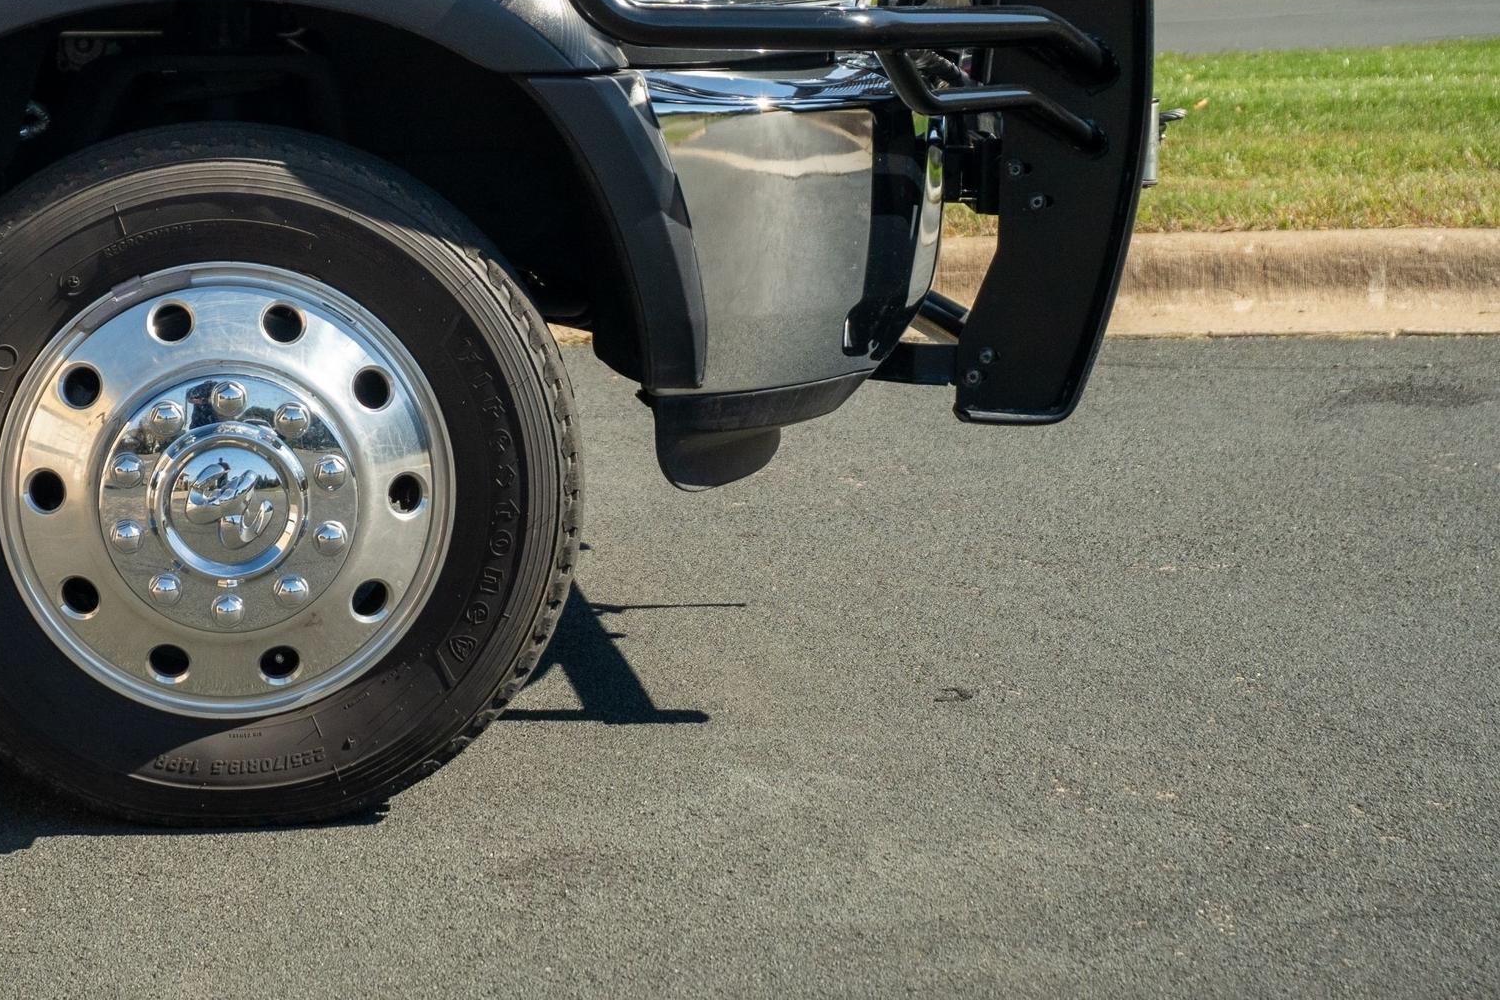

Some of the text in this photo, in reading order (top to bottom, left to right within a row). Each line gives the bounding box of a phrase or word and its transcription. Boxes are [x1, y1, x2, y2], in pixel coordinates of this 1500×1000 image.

[455, 335, 521, 624] Firestone
[152, 746, 327, 777] 225/70R19.5 14PR
